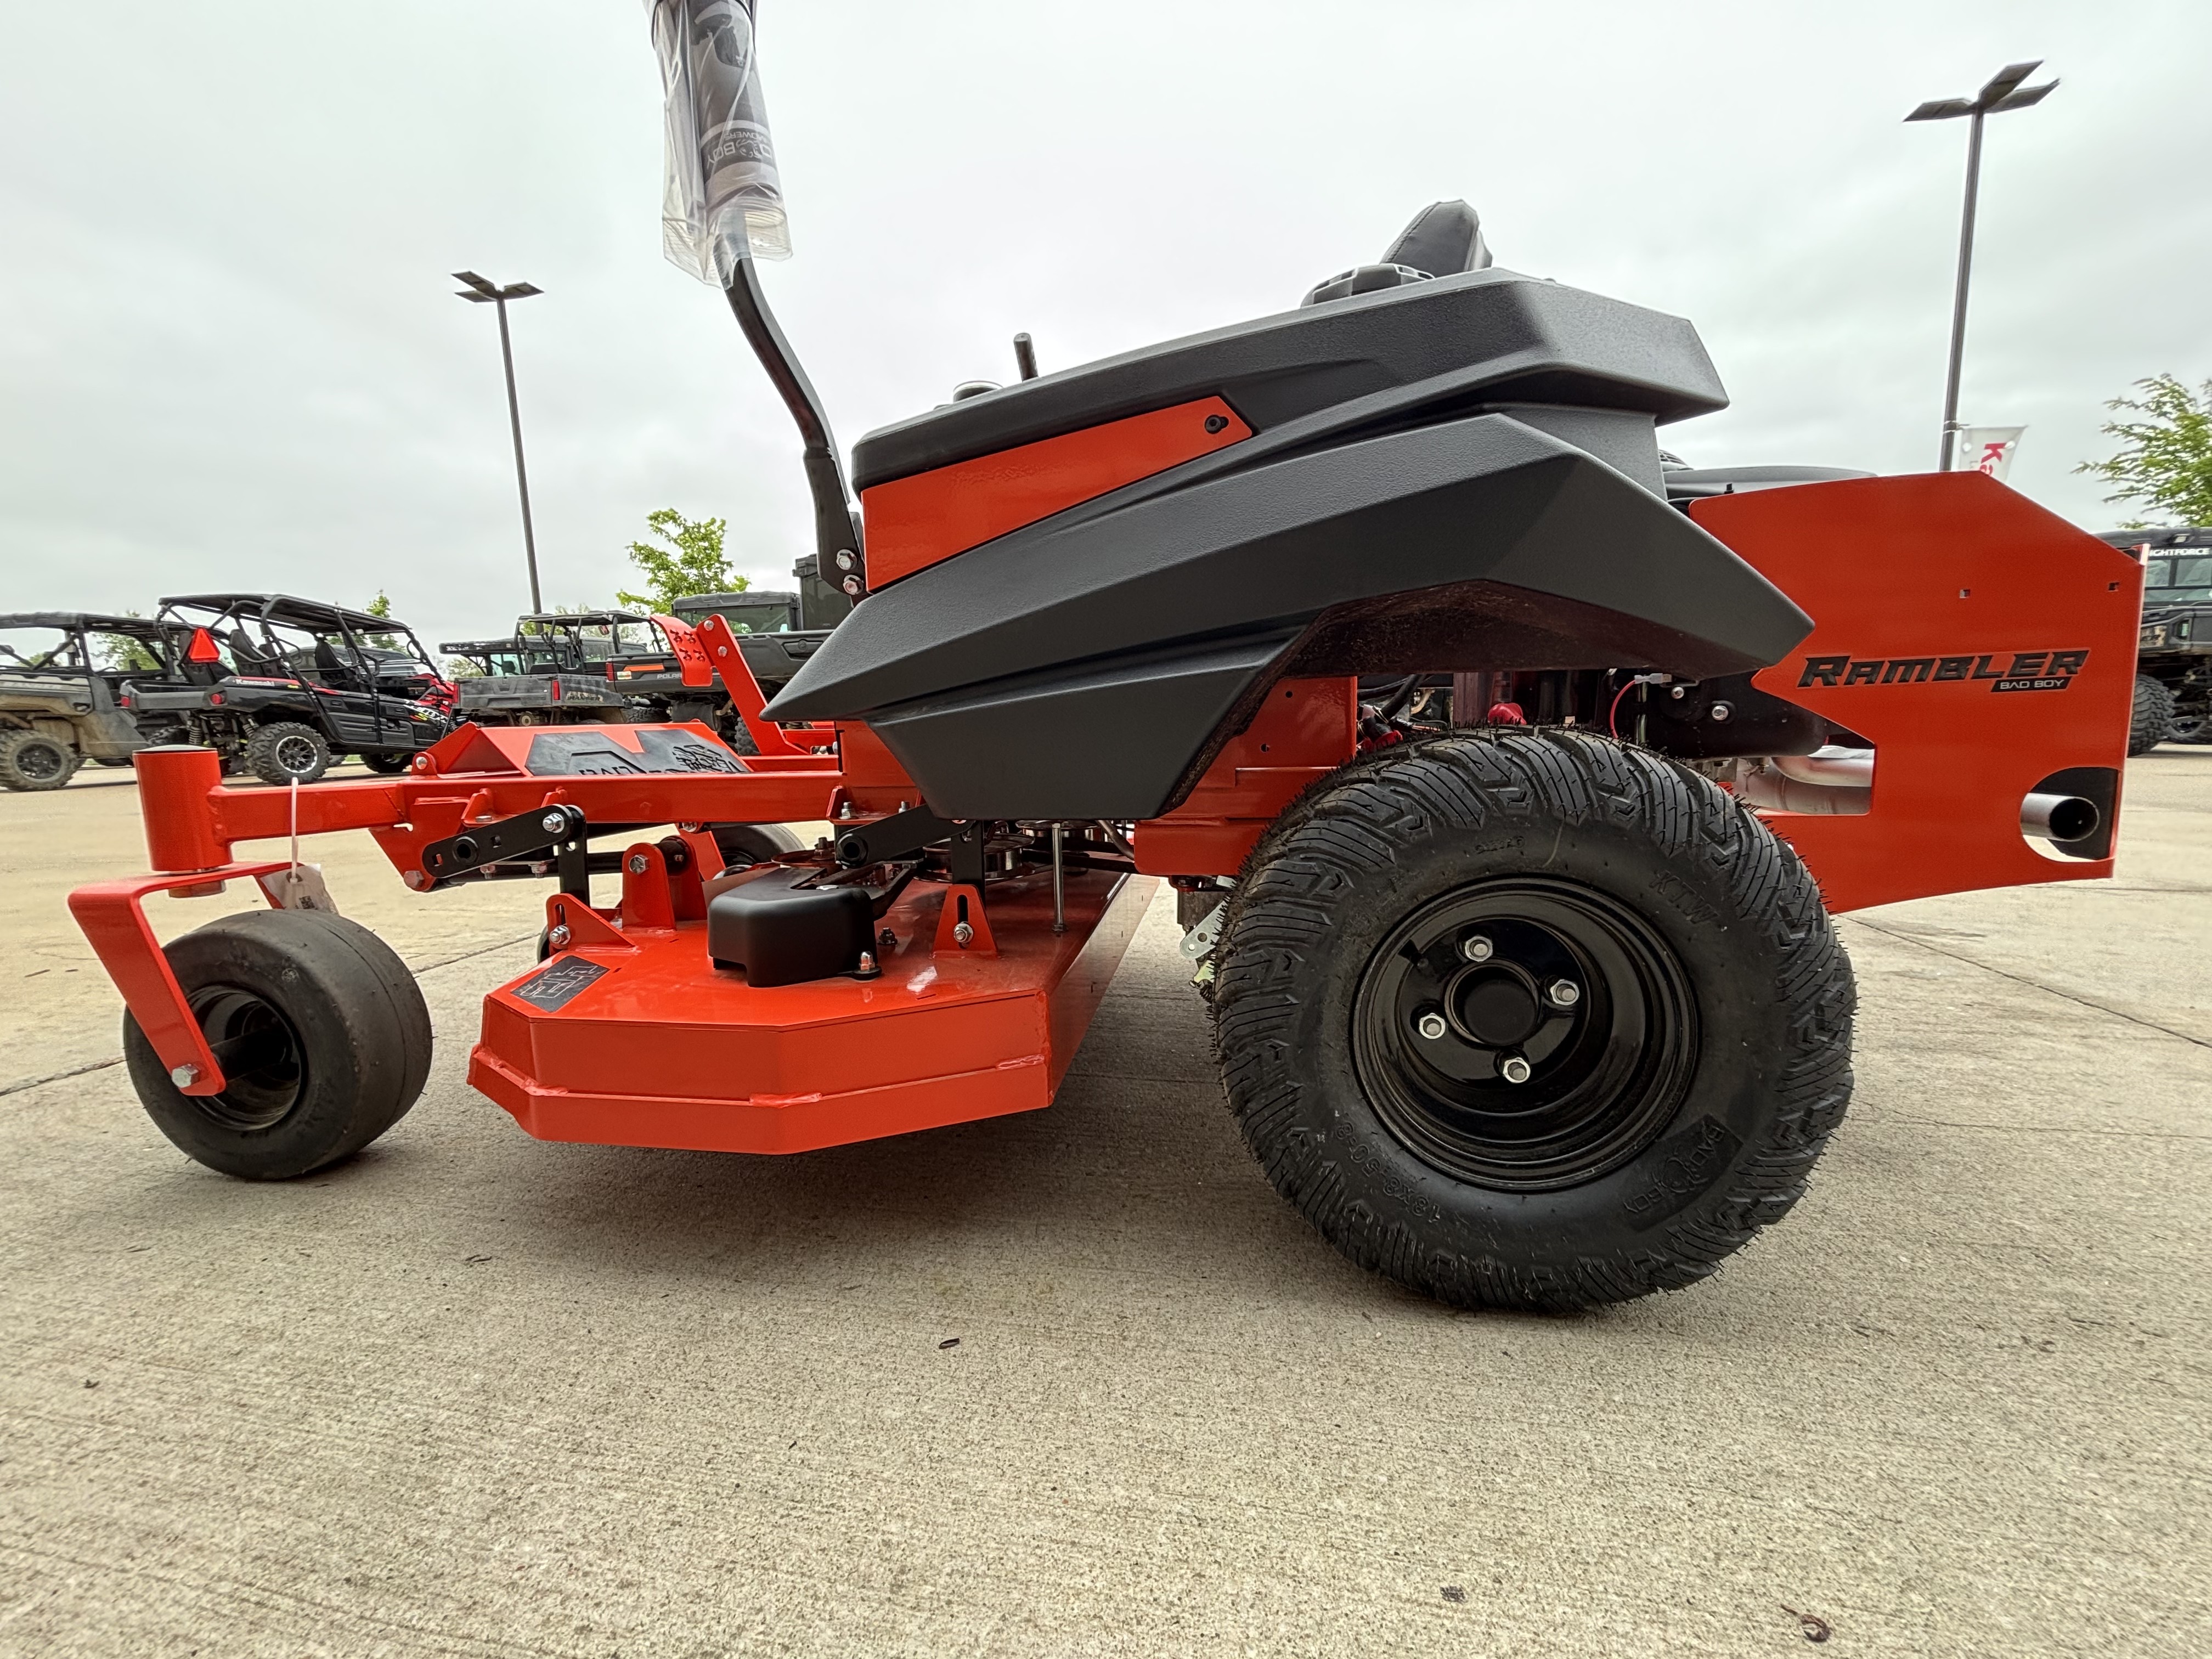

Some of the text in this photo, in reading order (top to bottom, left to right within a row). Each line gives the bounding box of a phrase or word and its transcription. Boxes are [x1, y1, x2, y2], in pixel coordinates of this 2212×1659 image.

[707, 142, 736, 170] BOY
[1797, 650, 2090, 687] RAMBLER
[2000, 679, 2064, 690] BAD BOY
